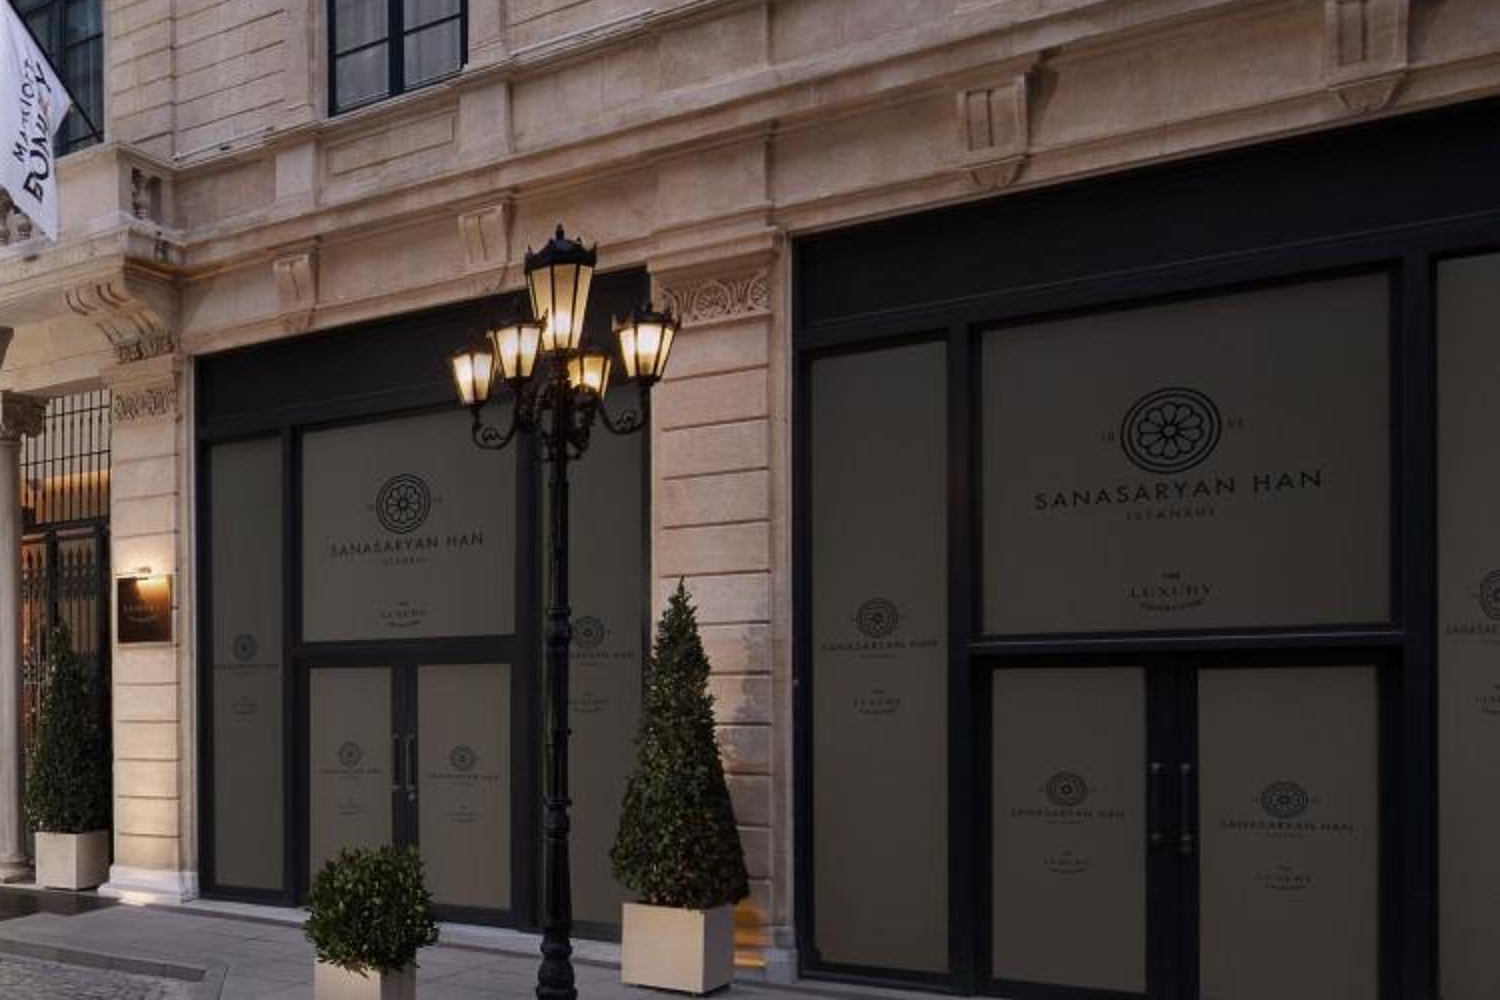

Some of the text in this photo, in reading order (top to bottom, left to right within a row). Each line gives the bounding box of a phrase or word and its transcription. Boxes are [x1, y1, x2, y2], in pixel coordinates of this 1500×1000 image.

[1034, 469, 1322, 511] SANASARYAN HAN
[446, 530, 484, 551] HAN
